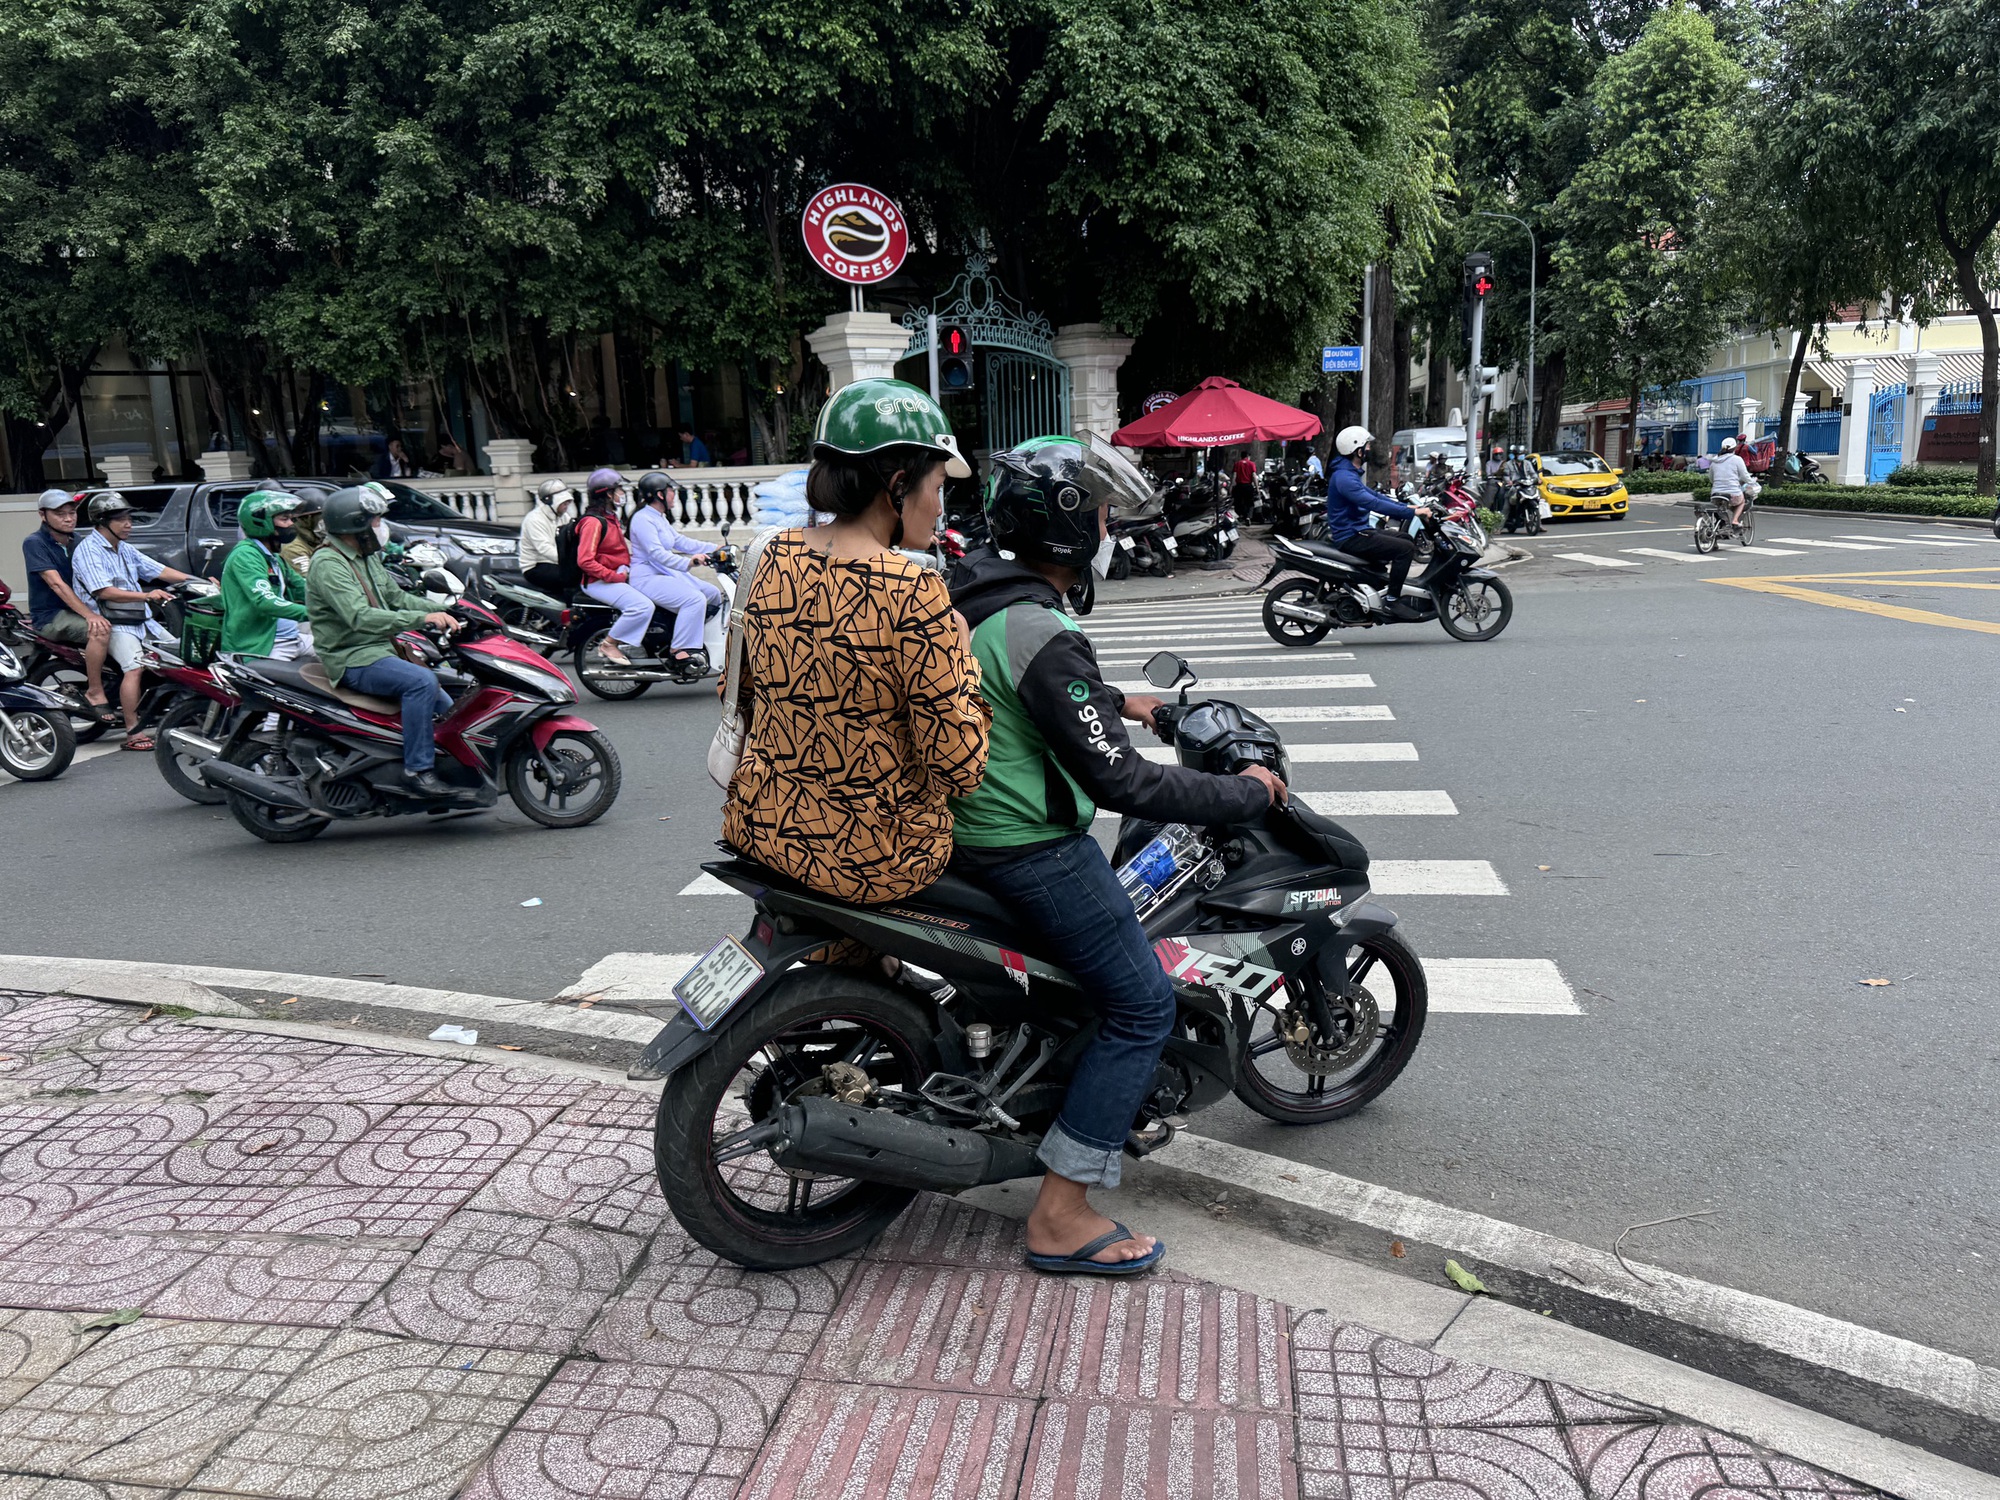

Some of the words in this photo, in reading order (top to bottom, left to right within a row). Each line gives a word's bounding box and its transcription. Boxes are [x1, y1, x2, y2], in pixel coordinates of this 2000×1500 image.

[808, 189, 903, 233] HIGHLANDS
[823, 253, 894, 278] COFFEE
[875, 393, 930, 415] Grab
[1219, 433, 1245, 441] COFFEE
[1052, 546, 1072, 554] gojek
[1078, 705, 1123, 766] gojek
[1290, 888, 1341, 904] SPECIAL
[1168, 947, 1284, 998] 150
